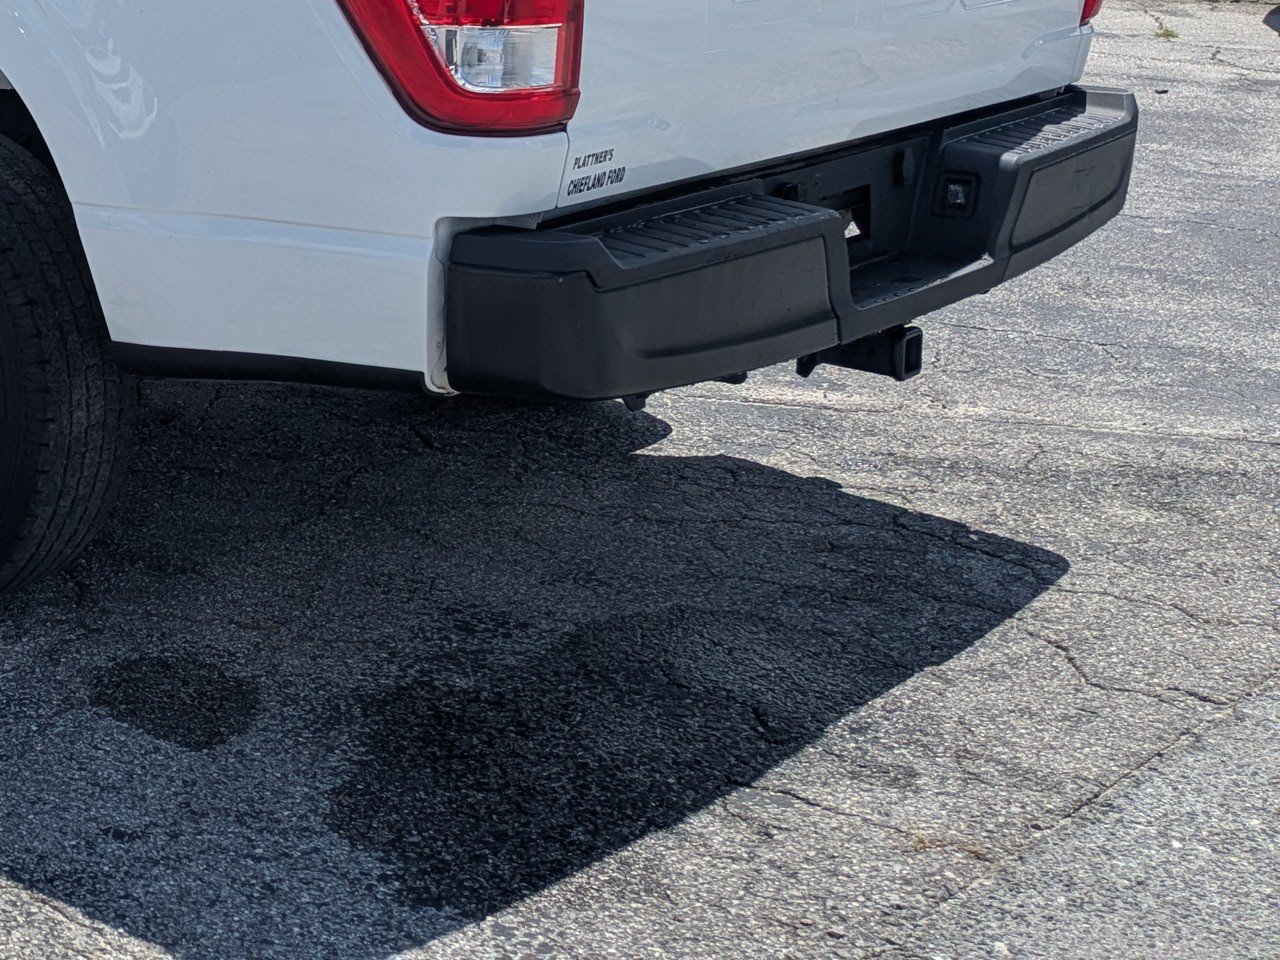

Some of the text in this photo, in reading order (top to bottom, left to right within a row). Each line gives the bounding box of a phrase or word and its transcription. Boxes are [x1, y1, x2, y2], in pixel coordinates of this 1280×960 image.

[572, 148, 615, 171] PLATTNER'S
[566, 166, 626, 197] CHIEFLAND FORD
